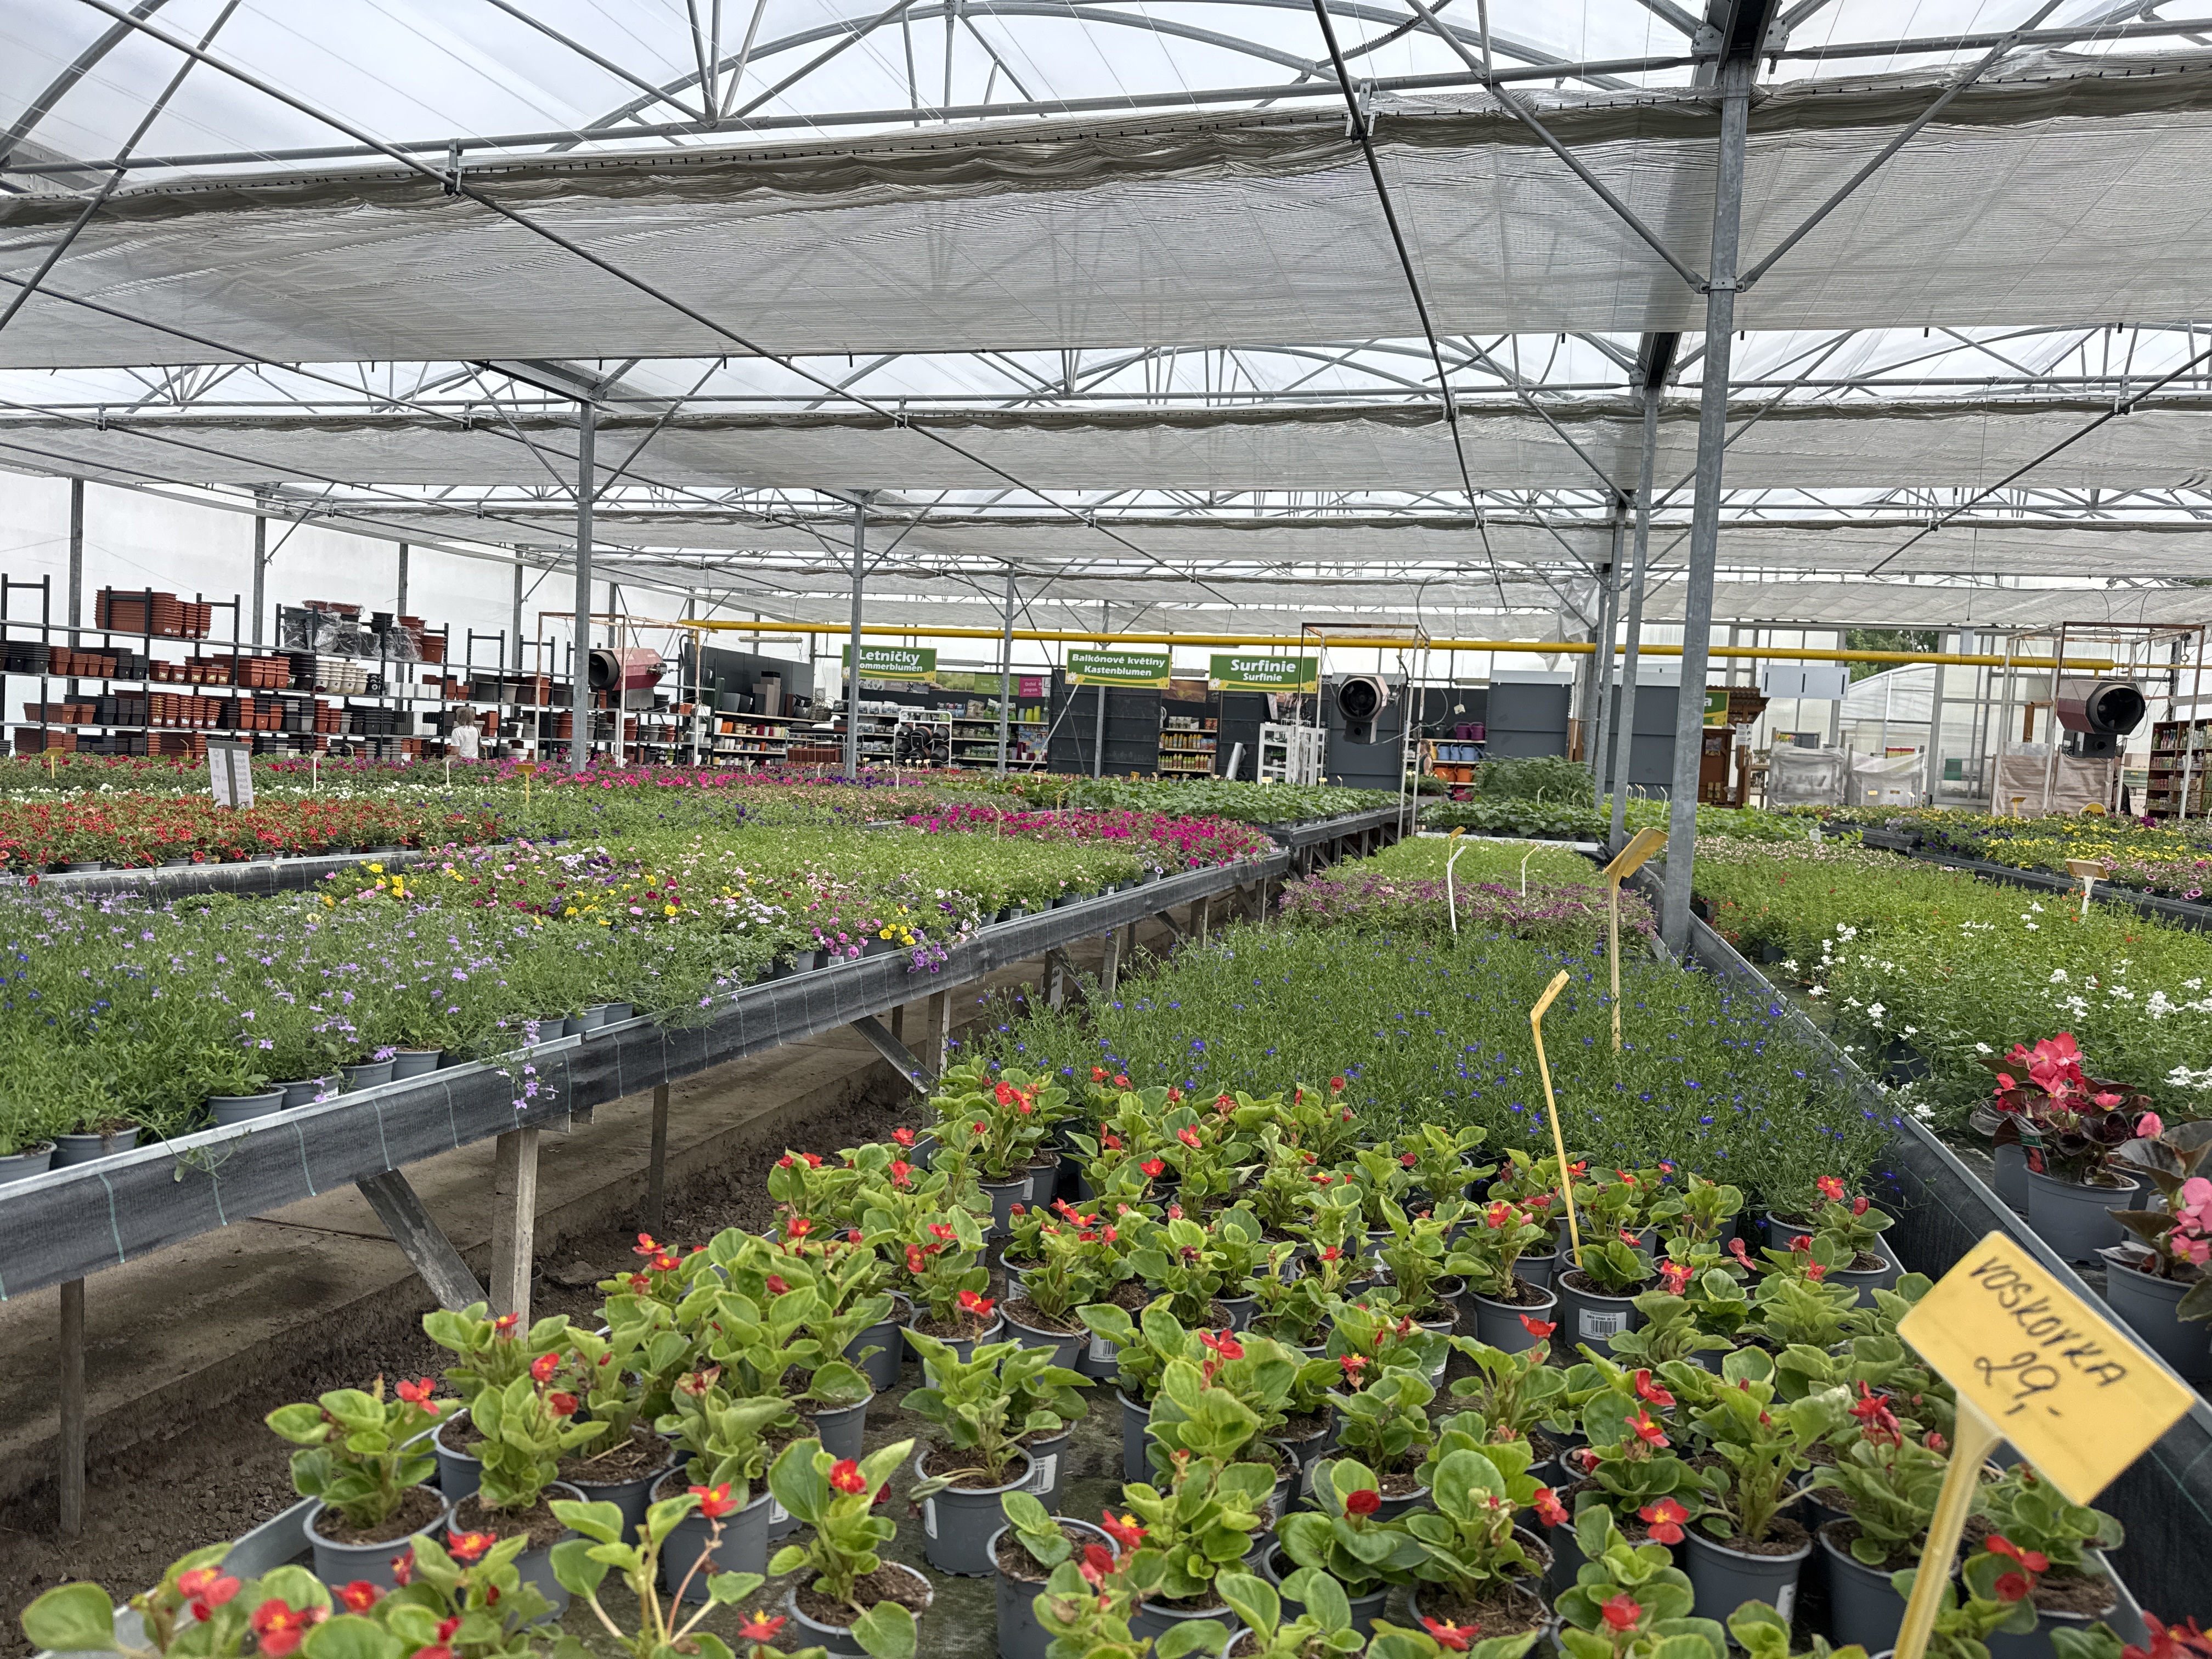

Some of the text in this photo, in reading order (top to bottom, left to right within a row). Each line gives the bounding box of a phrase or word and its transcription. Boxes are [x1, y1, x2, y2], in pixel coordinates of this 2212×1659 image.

[860, 650, 920, 666] Letničky
[1072, 653, 1166, 668] Balkónové květiny
[859, 663, 923, 672] ommerblumen
[1084, 665, 1152, 676] Kastenblumen
[1231, 659, 1296, 672] Surfinie
[1243, 673, 1283, 681] Surfinie
